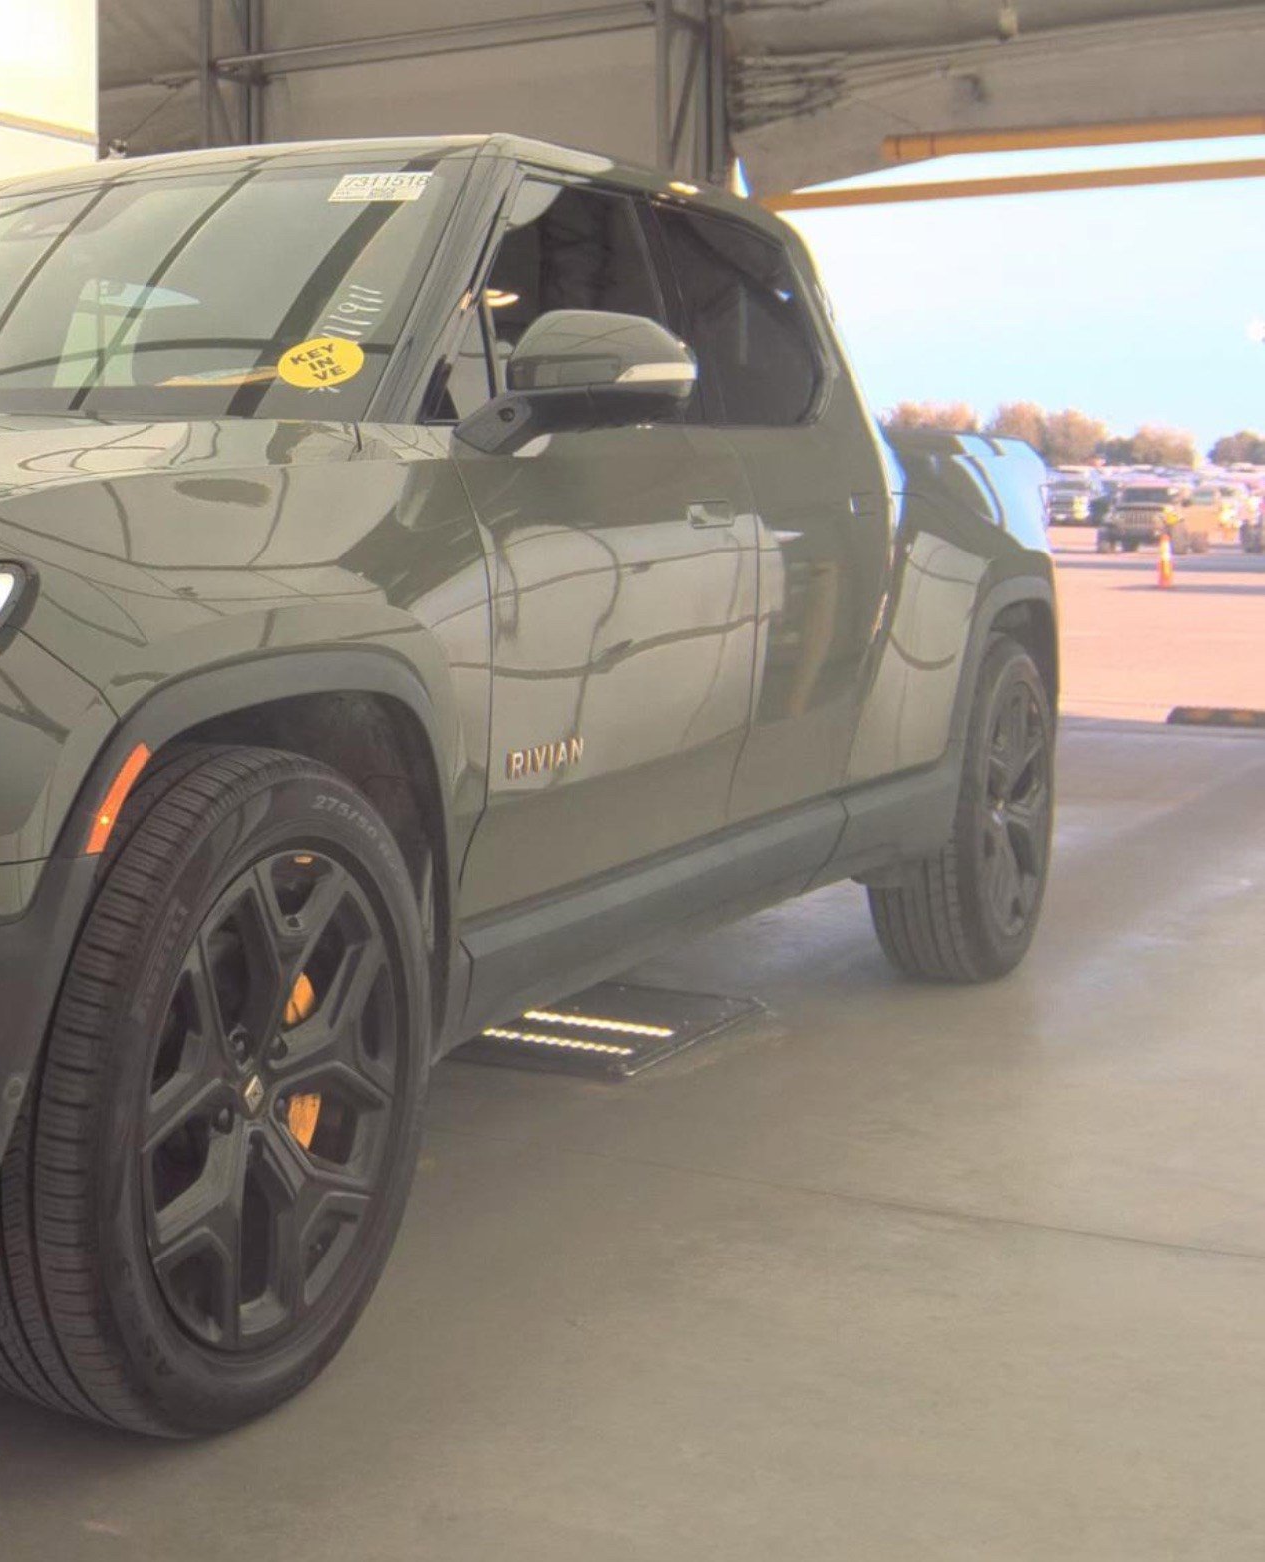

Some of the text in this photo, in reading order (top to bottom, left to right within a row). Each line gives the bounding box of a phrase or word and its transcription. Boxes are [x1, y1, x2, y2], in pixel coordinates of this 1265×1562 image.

[290, 343, 336, 365] KEY
[309, 356, 335, 371] IN
[507, 737, 584, 779] RIVIAN
